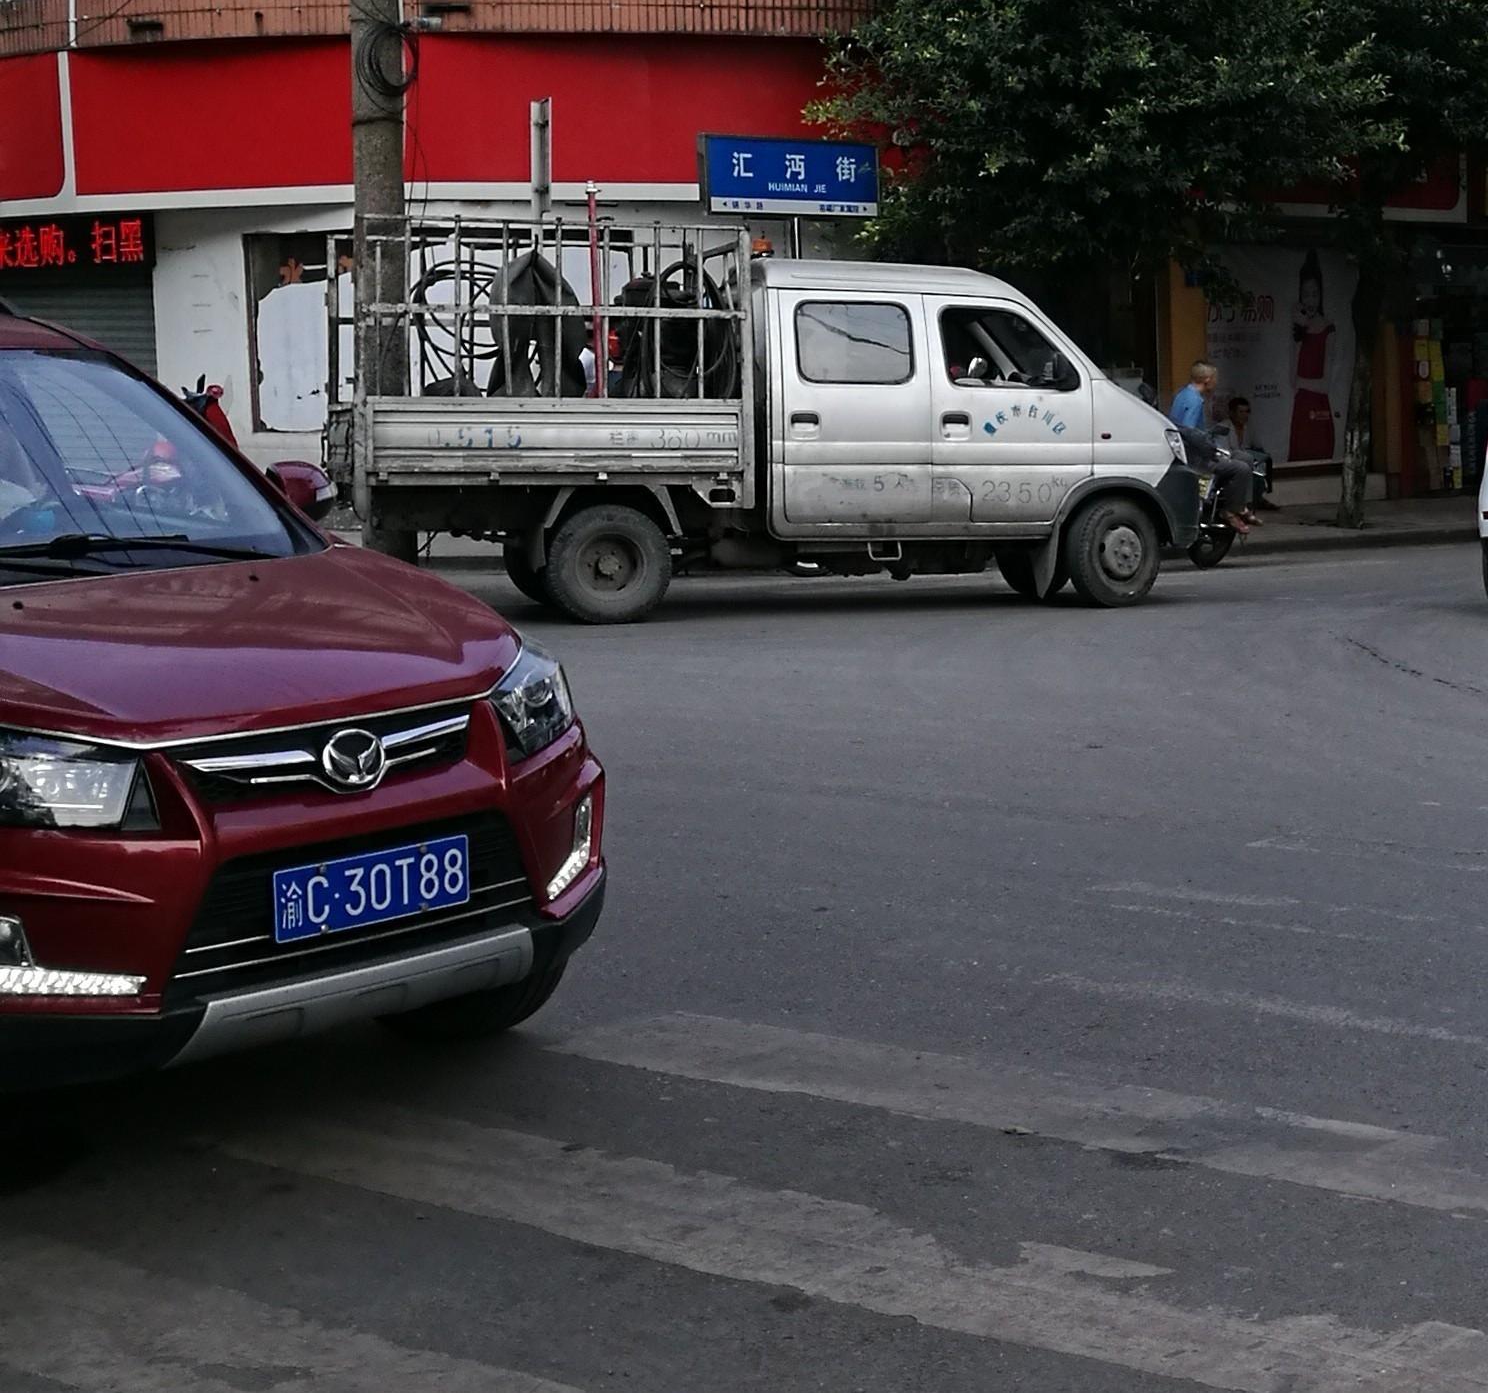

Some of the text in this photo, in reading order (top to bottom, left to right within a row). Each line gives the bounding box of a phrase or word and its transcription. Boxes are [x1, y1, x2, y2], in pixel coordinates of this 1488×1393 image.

[768, 182, 827, 194] HUIMIAN JIE
[981, 478, 1053, 504] 2350
[281, 848, 465, 930] 渝C·30T88
